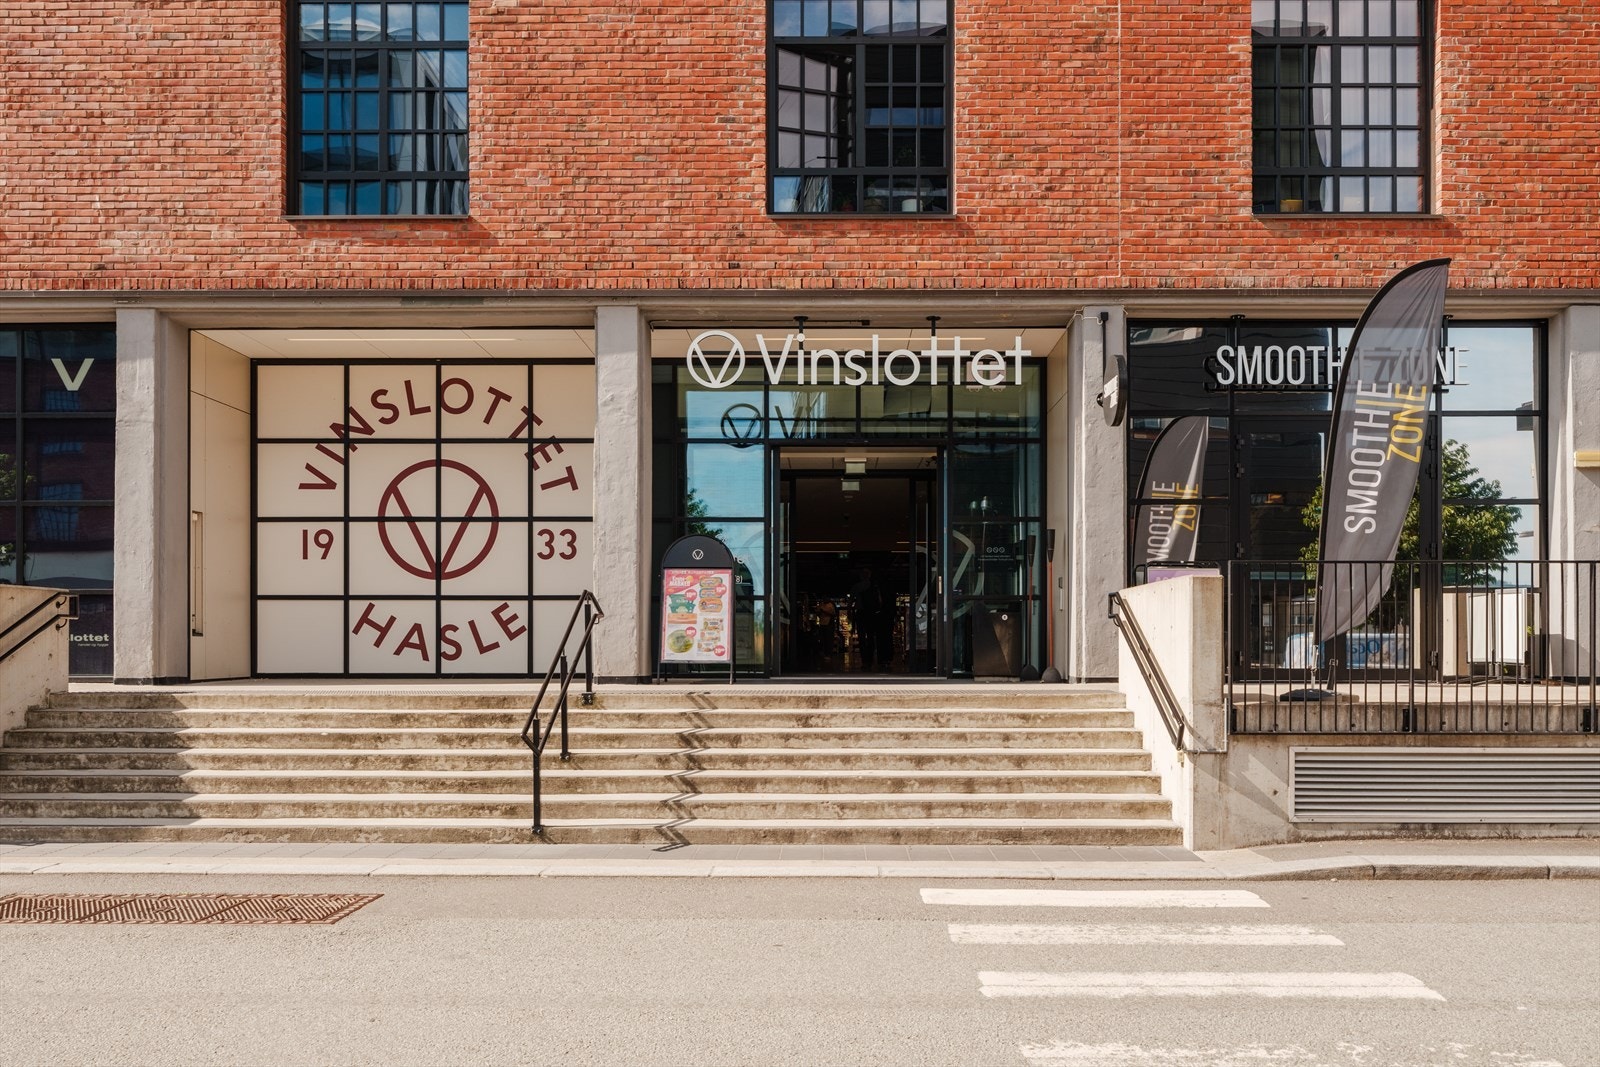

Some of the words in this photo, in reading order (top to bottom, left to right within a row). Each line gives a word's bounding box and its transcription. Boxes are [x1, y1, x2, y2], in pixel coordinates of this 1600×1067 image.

[756, 333, 1031, 386] Vinslottet
[298, 377, 578, 492] VINSLOTTET
[1344, 380, 1394, 535] SMOOTHIE
[1386, 384, 1427, 463] ZONE
[302, 529, 334, 560] 19
[536, 529, 577, 560] 33
[1146, 480, 1176, 563] MOOTHIE
[352, 602, 527, 662] HASLE
